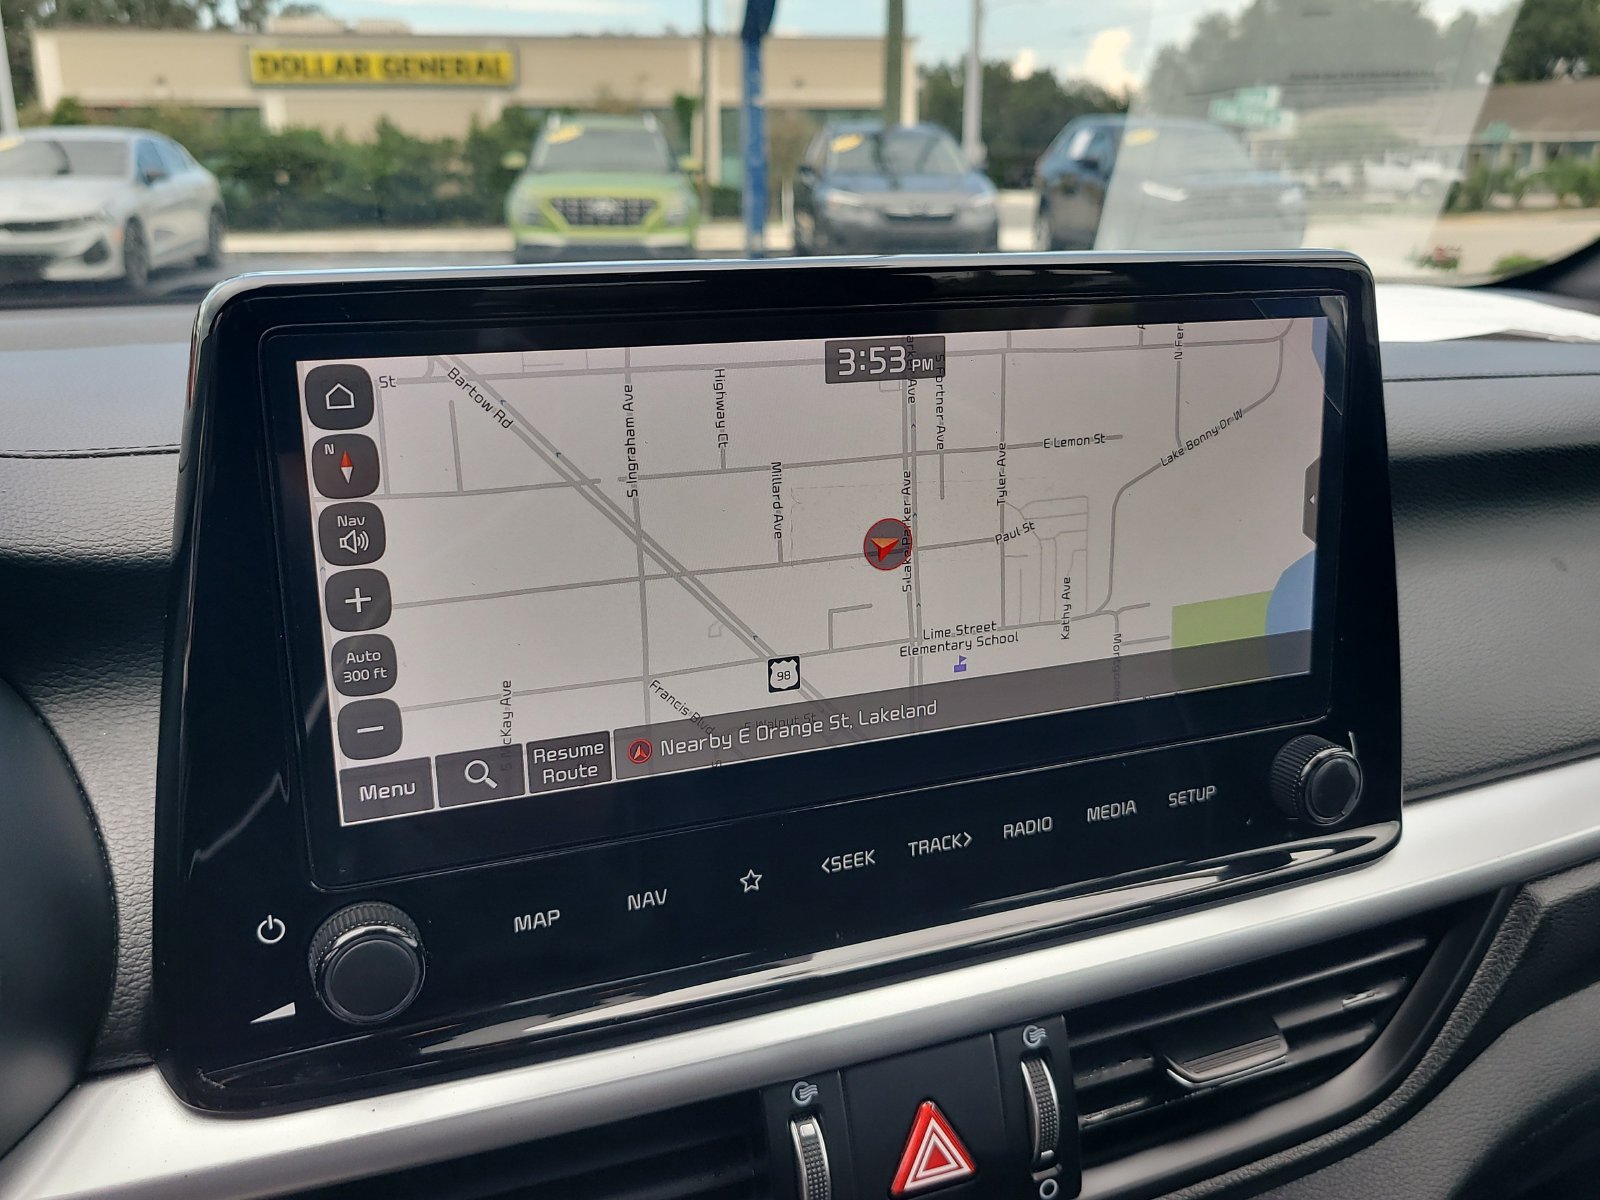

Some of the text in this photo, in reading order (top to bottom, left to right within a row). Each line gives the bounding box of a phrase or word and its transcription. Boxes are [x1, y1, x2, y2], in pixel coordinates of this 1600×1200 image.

[256, 54, 506, 83] DOLLAR GENERAL
[838, 345, 934, 377] 3:53 PM
[1174, 351, 1183, 360] N
[379, 375, 397, 389] St
[907, 378, 918, 404] Ave
[935, 366, 946, 420] Fortner
[447, 366, 514, 429] Bartow Rd
[712, 368, 729, 449] Highway Ct
[324, 443, 336, 456] N
[622, 384, 639, 498] S Ingraham Ave
[936, 425, 946, 450] Ave
[1043, 433, 1106, 449] E Lemon St
[1160, 408, 1243, 468] Lake Bonny Dr W
[996, 442, 1008, 507] Tyler Ave
[770, 461, 784, 540] Millard Ave
[337, 514, 366, 528] Nav
[901, 470, 912, 593] S Lake Parker Ave
[995, 521, 1035, 545] Paul St
[1060, 577, 1072, 641] Kathy Ave
[923, 620, 998, 641] Lime Street
[899, 631, 1020, 657] Elementary School
[345, 650, 381, 664] Auto
[343, 667, 388, 684] 300 ft
[776, 671, 791, 682] 98
[500, 680, 512, 707] Ave
[649, 679, 715, 735] Francis Blvd
[661, 700, 938, 757] Nearby E Orange St, Lakeland
[533, 743, 605, 765] Resume
[543, 764, 598, 784] Route
[359, 782, 416, 802] Menu
[1168, 785, 1217, 808] SETUP
[1087, 799, 1138, 823] MEDIA
[1003, 816, 1053, 840] RADIO
[627, 888, 668, 912] NAV
[514, 909, 560, 934] MAP
